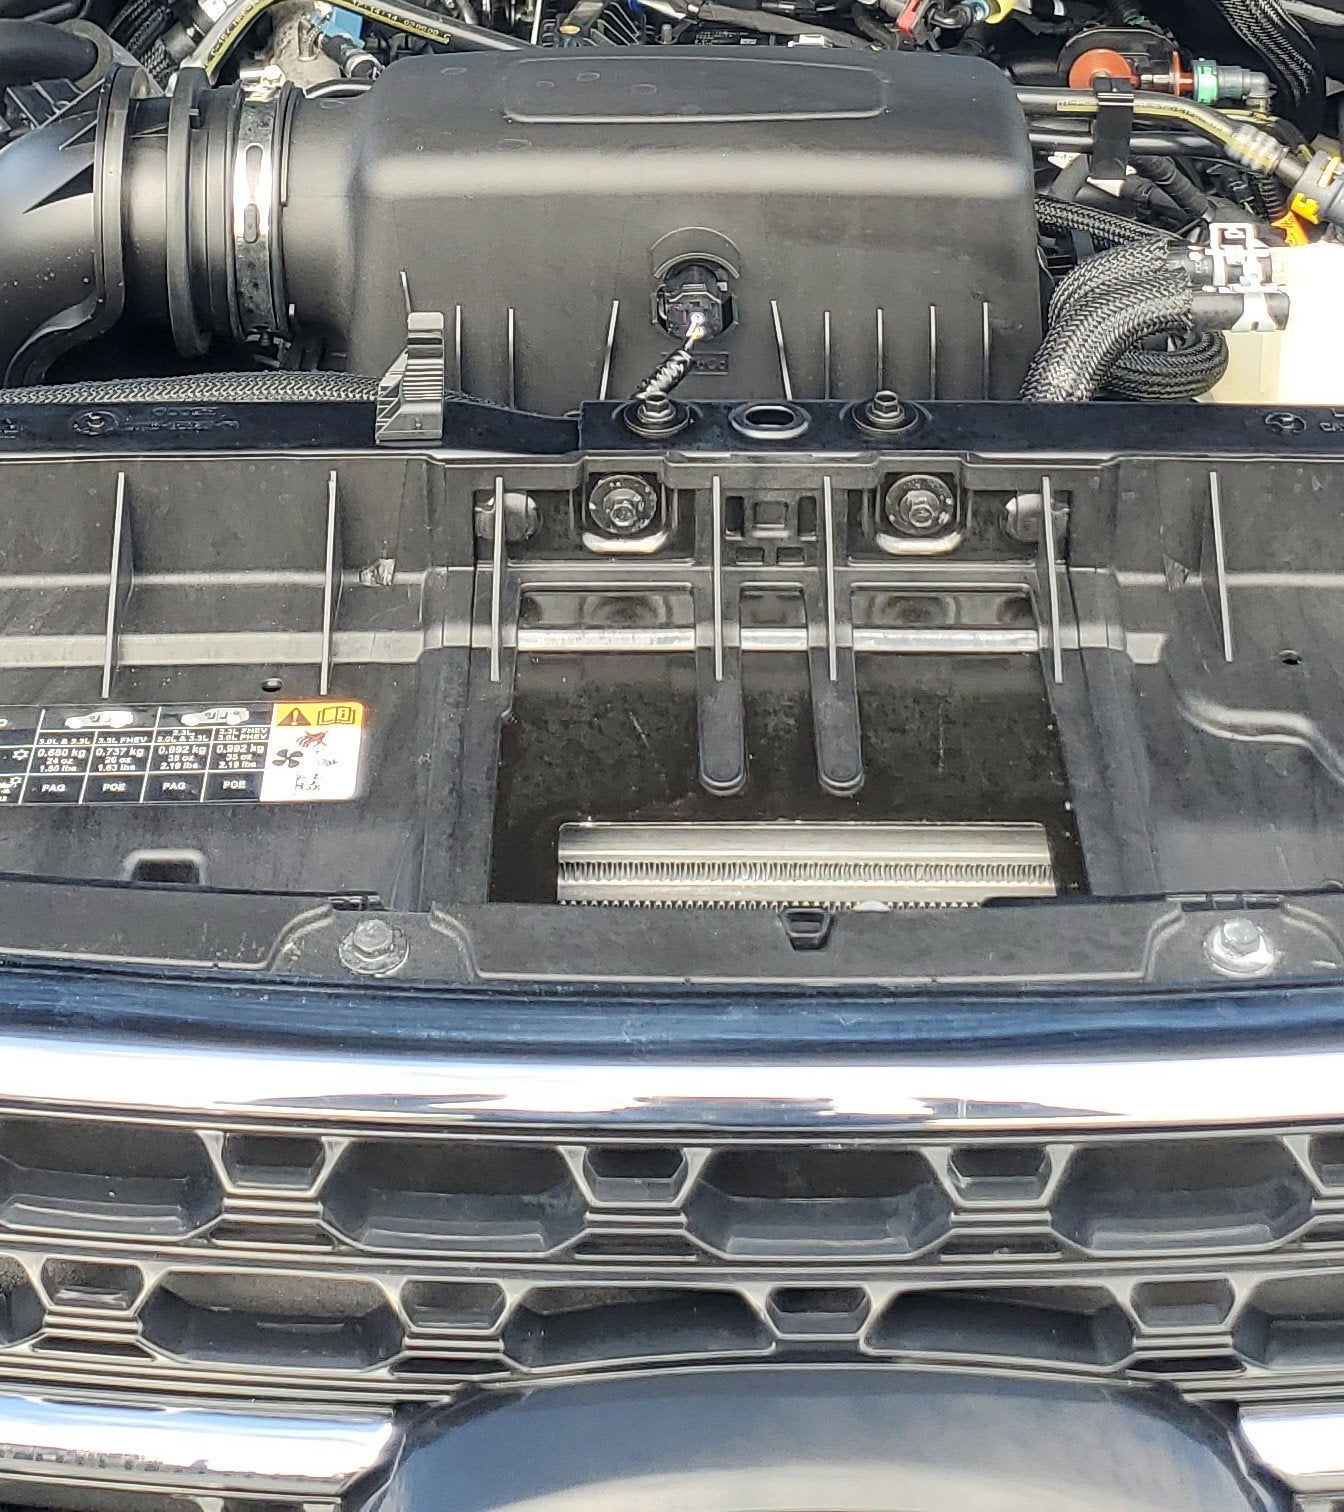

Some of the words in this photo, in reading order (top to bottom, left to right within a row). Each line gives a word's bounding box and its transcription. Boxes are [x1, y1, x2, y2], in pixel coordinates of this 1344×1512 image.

[71, 748, 86, 759] kg
[129, 746, 145, 758] kg
[191, 745, 207, 756] kg
[250, 744, 265, 754] kg
[41, 783, 66, 792] PAG
[102, 783, 126, 792] POE
[162, 781, 186, 790] PAG
[222, 780, 246, 790] POE
